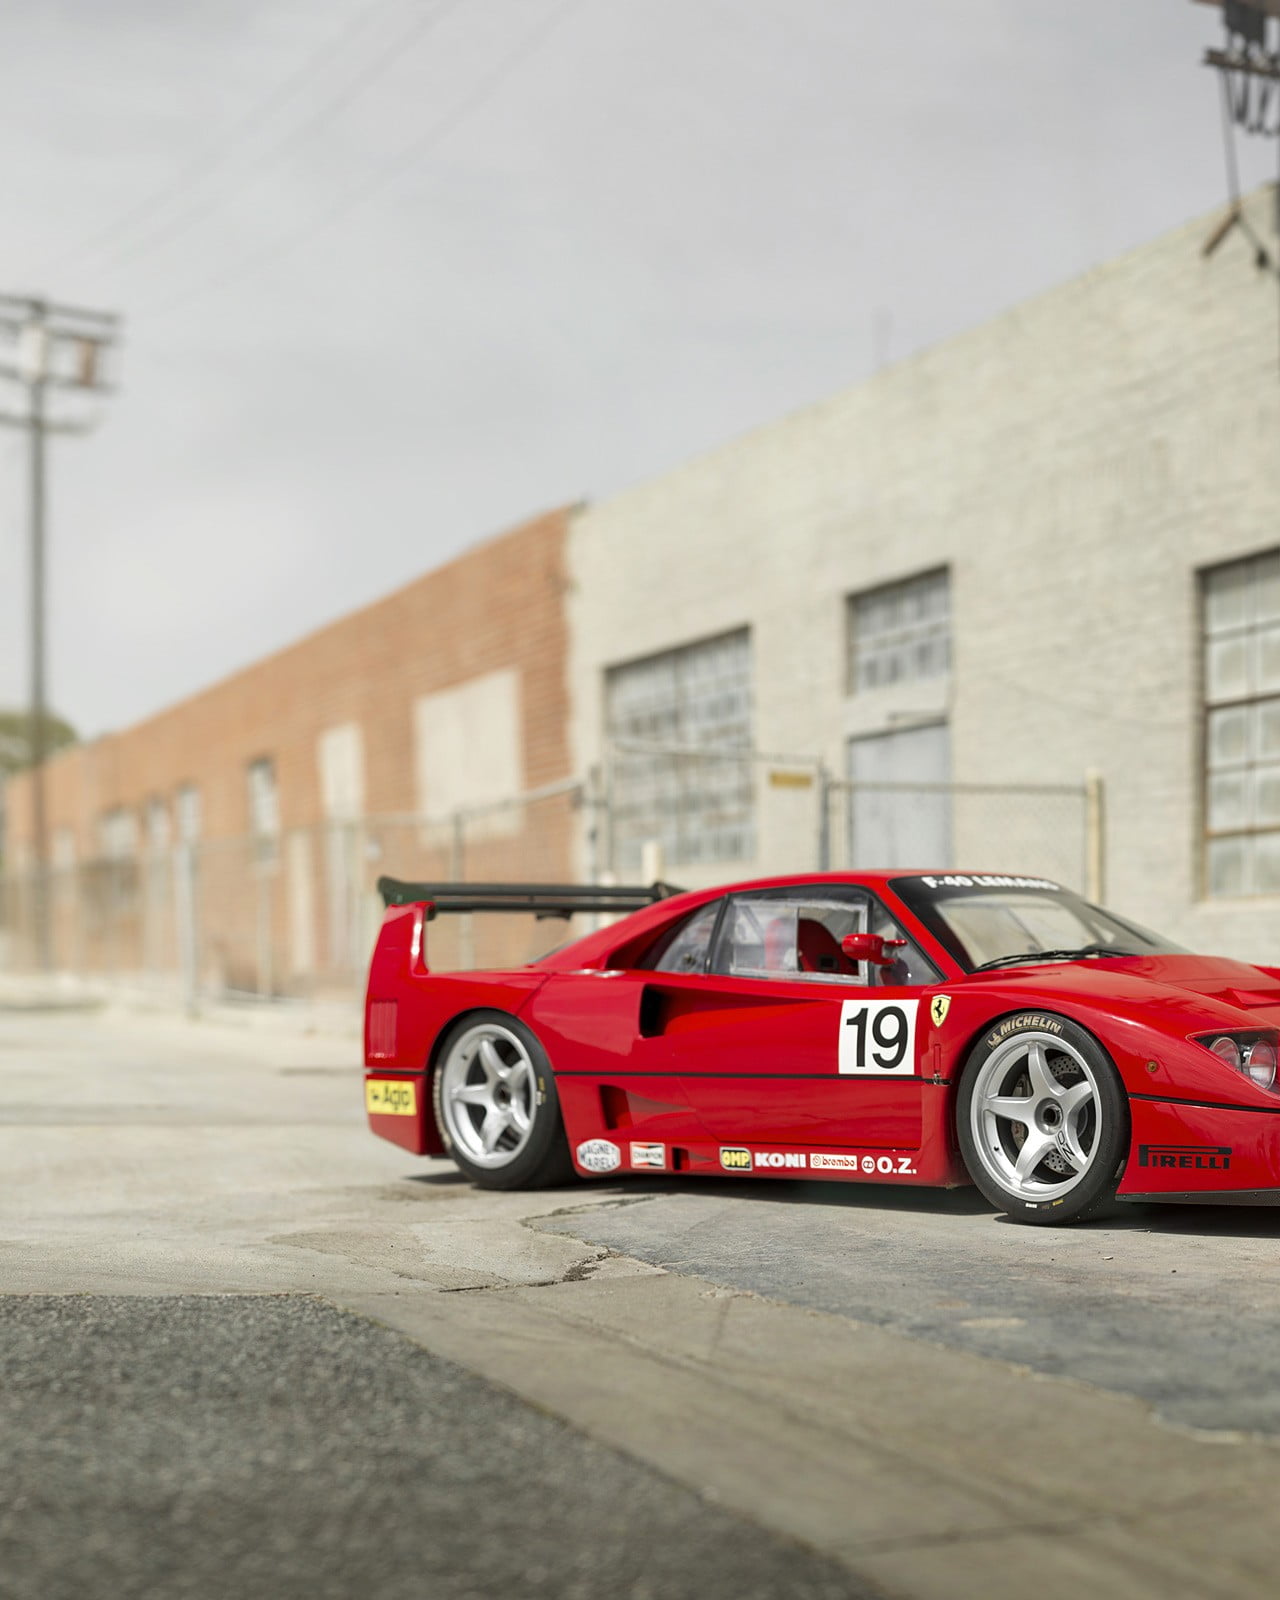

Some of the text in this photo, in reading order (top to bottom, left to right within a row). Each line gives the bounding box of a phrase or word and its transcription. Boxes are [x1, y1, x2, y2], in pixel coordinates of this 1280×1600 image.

[921, 876, 973, 888] F-40
[1000, 1015, 1062, 1034] MICHELIN
[846, 1006, 908, 1069] 19
[722, 1150, 750, 1167] OMP
[754, 1152, 807, 1168] KONI
[822, 1155, 855, 1168] brembo
[877, 1156, 918, 1174] O.Z.
[1138, 1144, 1232, 1169] PIRELLI
